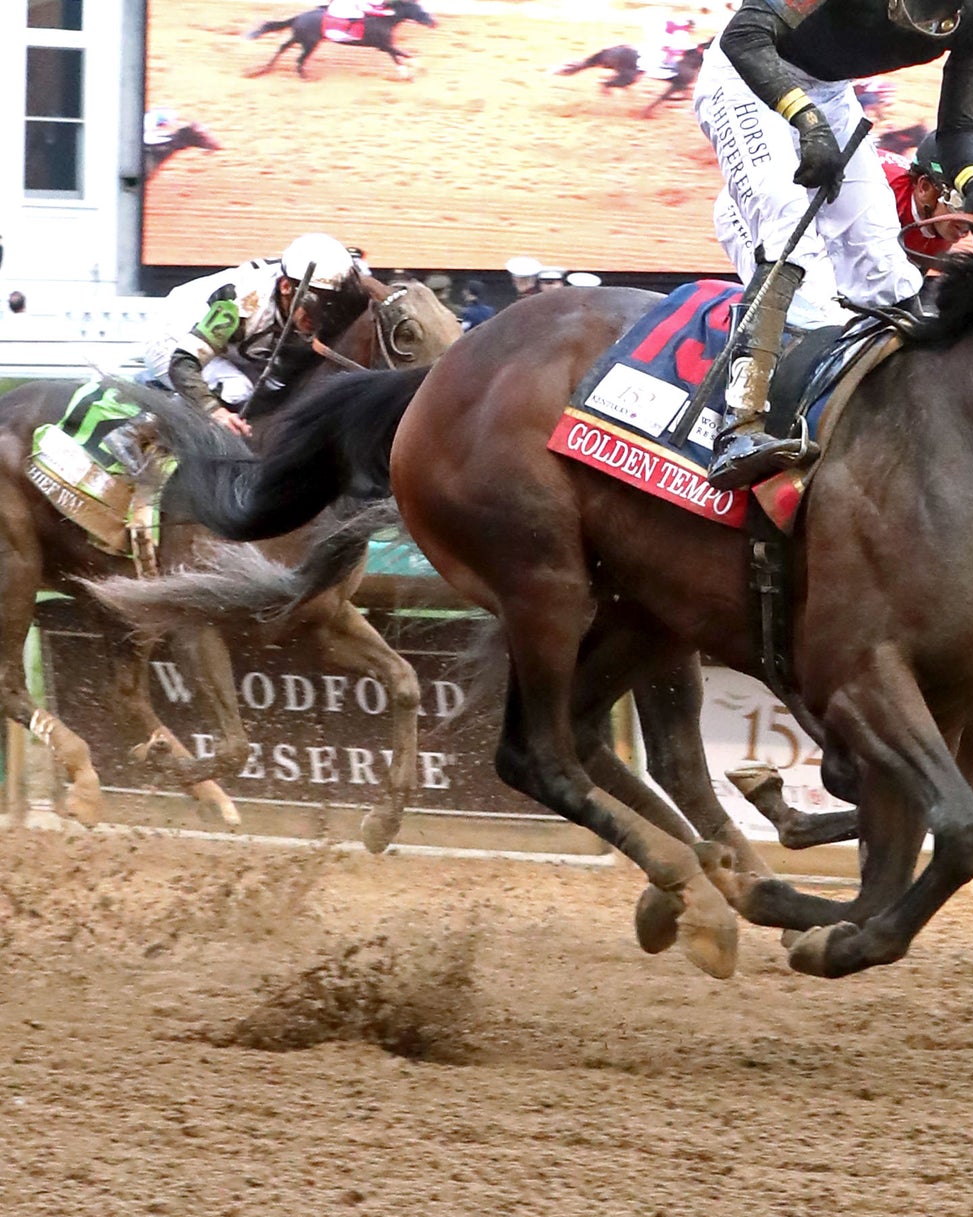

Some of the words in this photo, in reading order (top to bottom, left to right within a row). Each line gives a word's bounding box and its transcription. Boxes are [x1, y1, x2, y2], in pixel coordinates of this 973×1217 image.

[711, 86, 754, 205] WHISPERER
[734, 100, 772, 168] HORSE
[205, 304, 236, 339] 12
[28, 463, 61, 497] HIEF
[567, 422, 657, 482] GOLDEN
[656, 461, 735, 516] TEMPO
[151, 661, 467, 719] WODFOD
